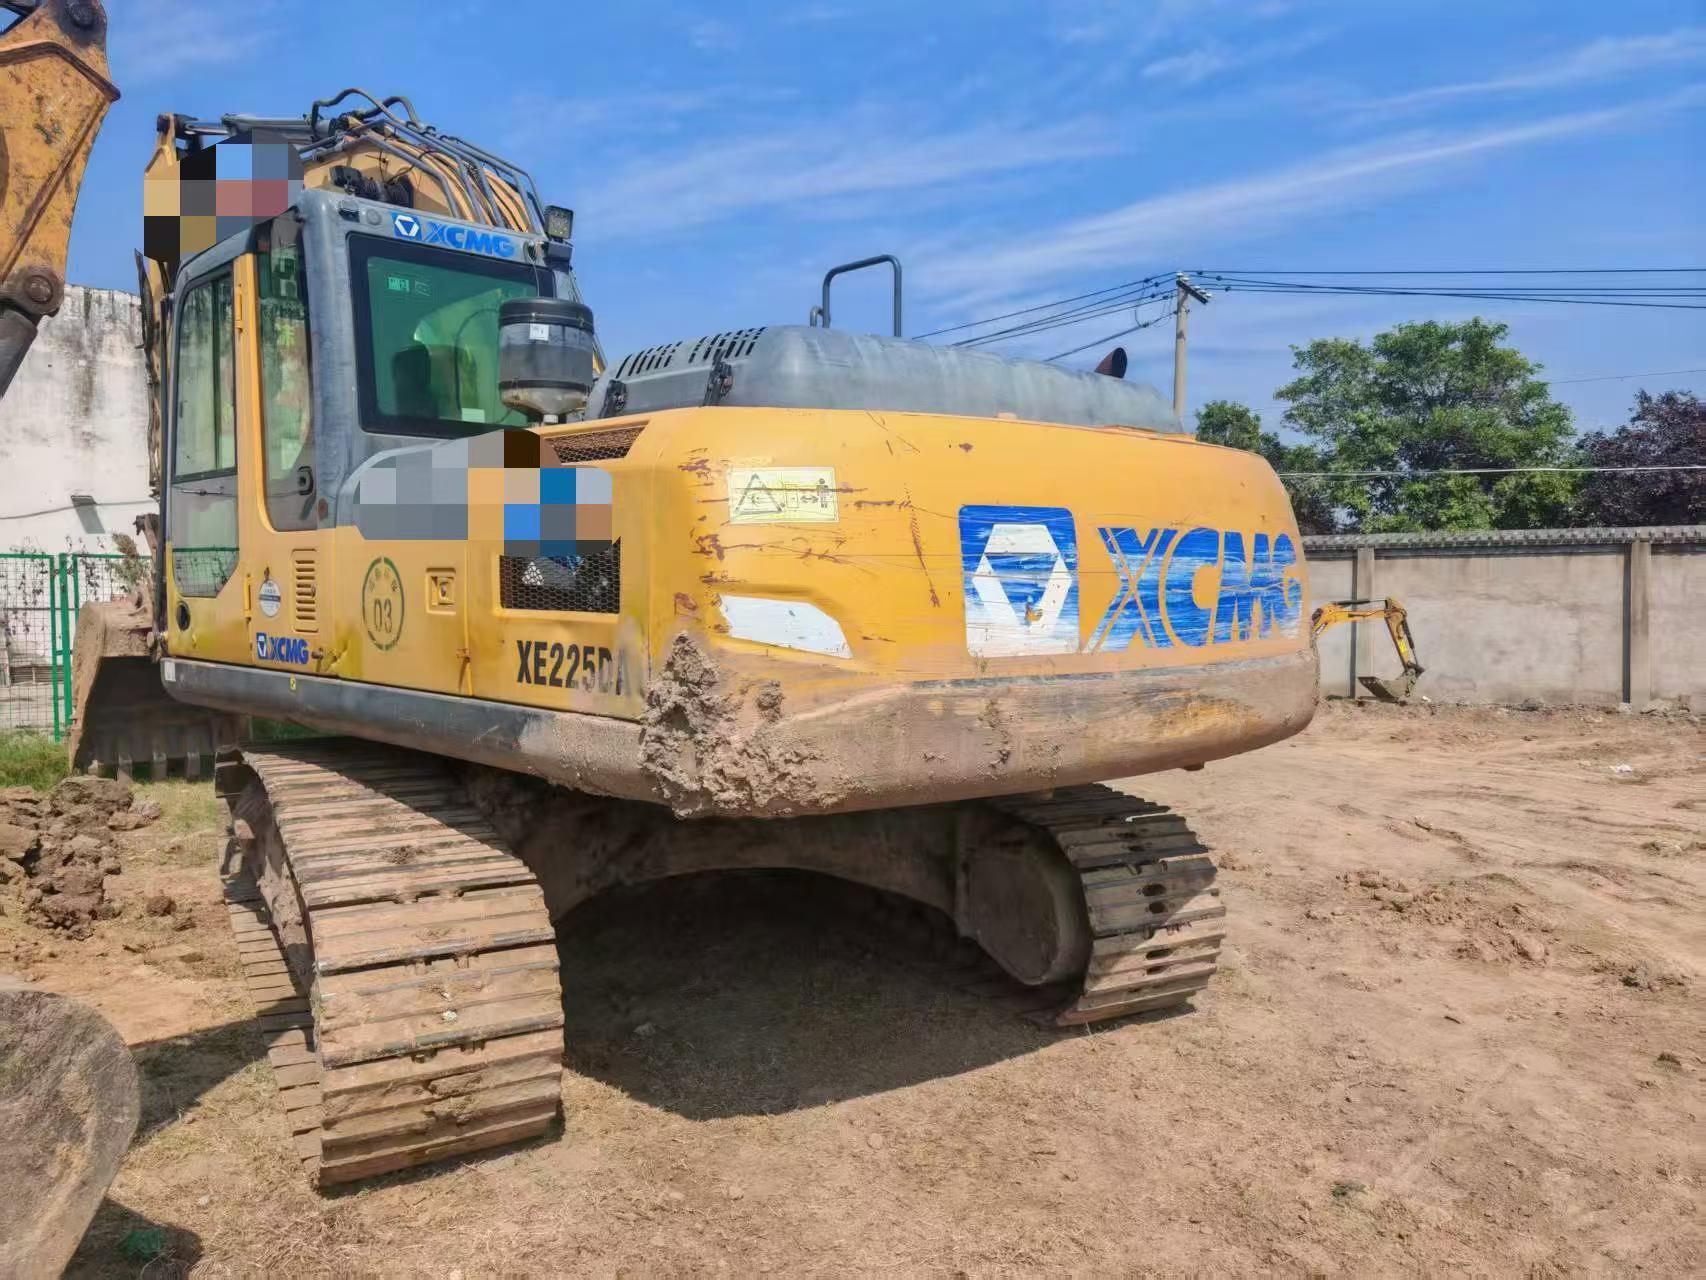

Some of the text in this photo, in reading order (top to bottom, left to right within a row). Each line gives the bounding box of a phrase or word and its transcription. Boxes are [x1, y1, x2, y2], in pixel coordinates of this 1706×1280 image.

[423, 221, 516, 257] XCMG
[1083, 527, 1303, 653] XCMG
[268, 636, 309, 664] XCMG
